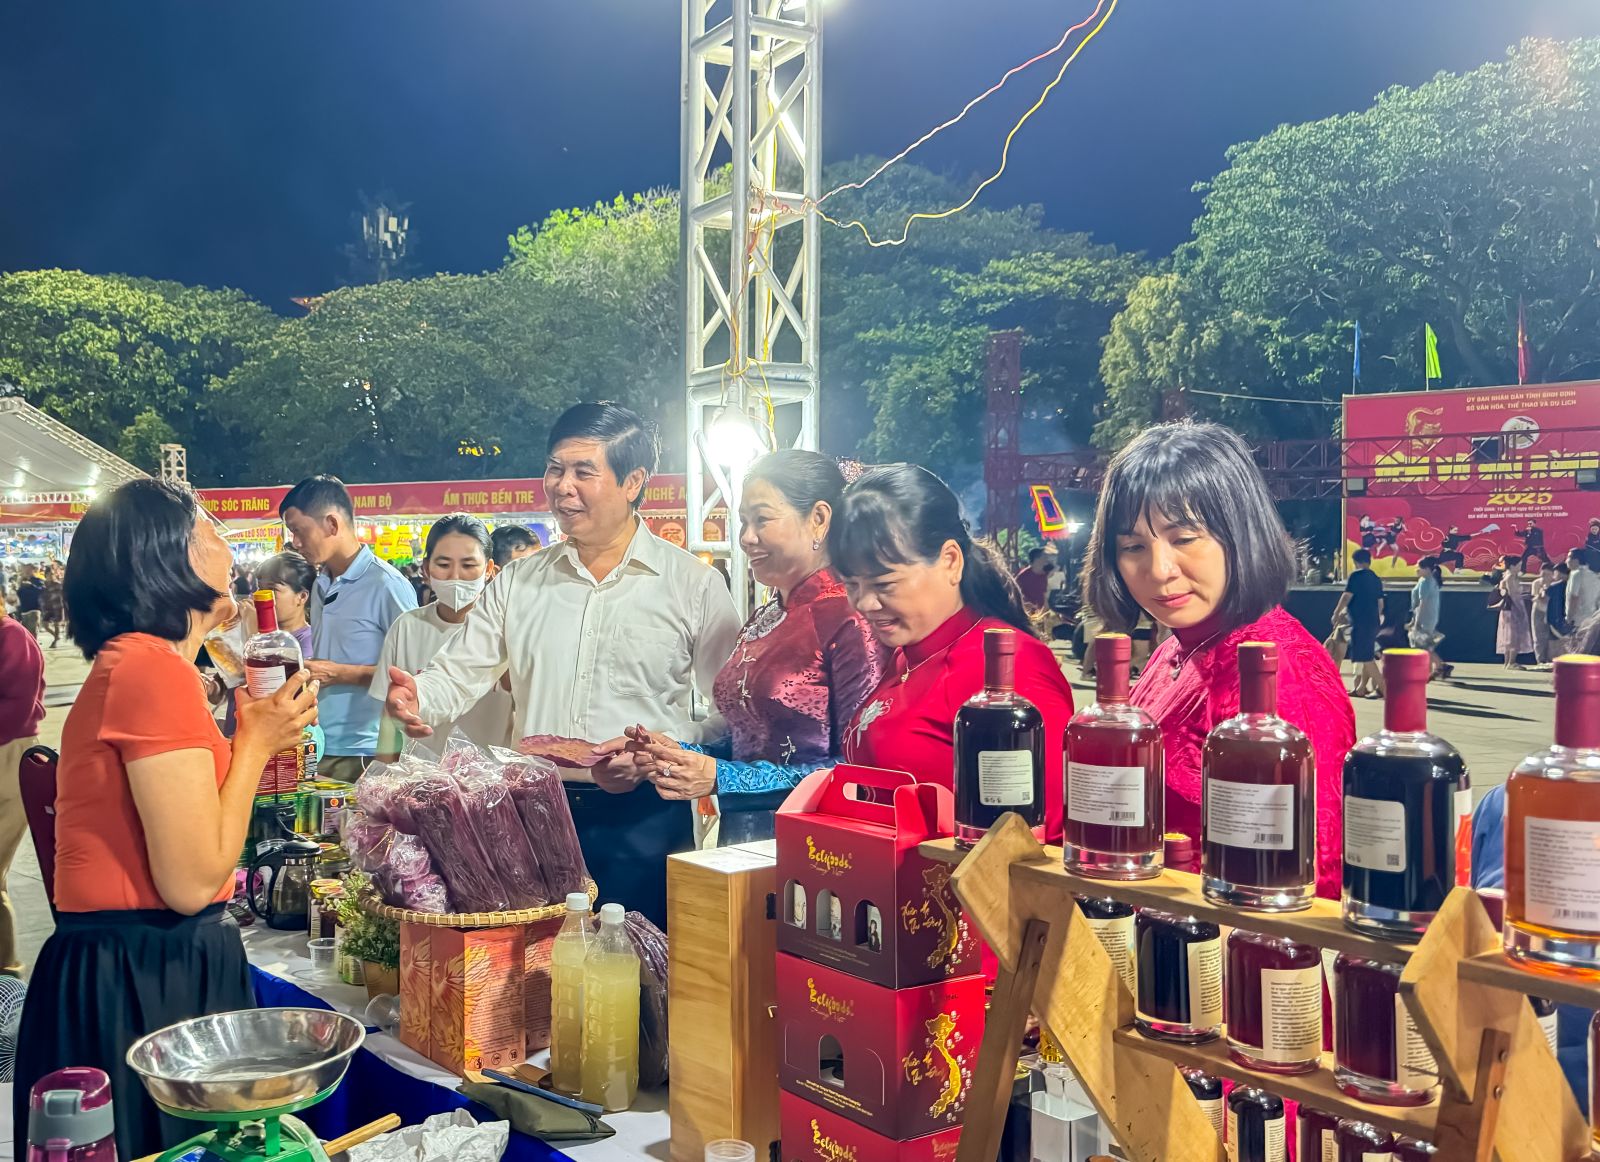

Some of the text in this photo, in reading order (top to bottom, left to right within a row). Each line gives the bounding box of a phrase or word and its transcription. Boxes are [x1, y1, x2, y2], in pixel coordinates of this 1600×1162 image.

[221, 497, 239, 511] SÓC
[241, 497, 270, 511] TRĂNG
[354, 492, 392, 511] NAM BỘ
[462, 491, 489, 507] THỰC
[491, 488, 512, 504] BẾN
[515, 491, 535, 504] TRE
[1486, 485, 1553, 505] 2025
